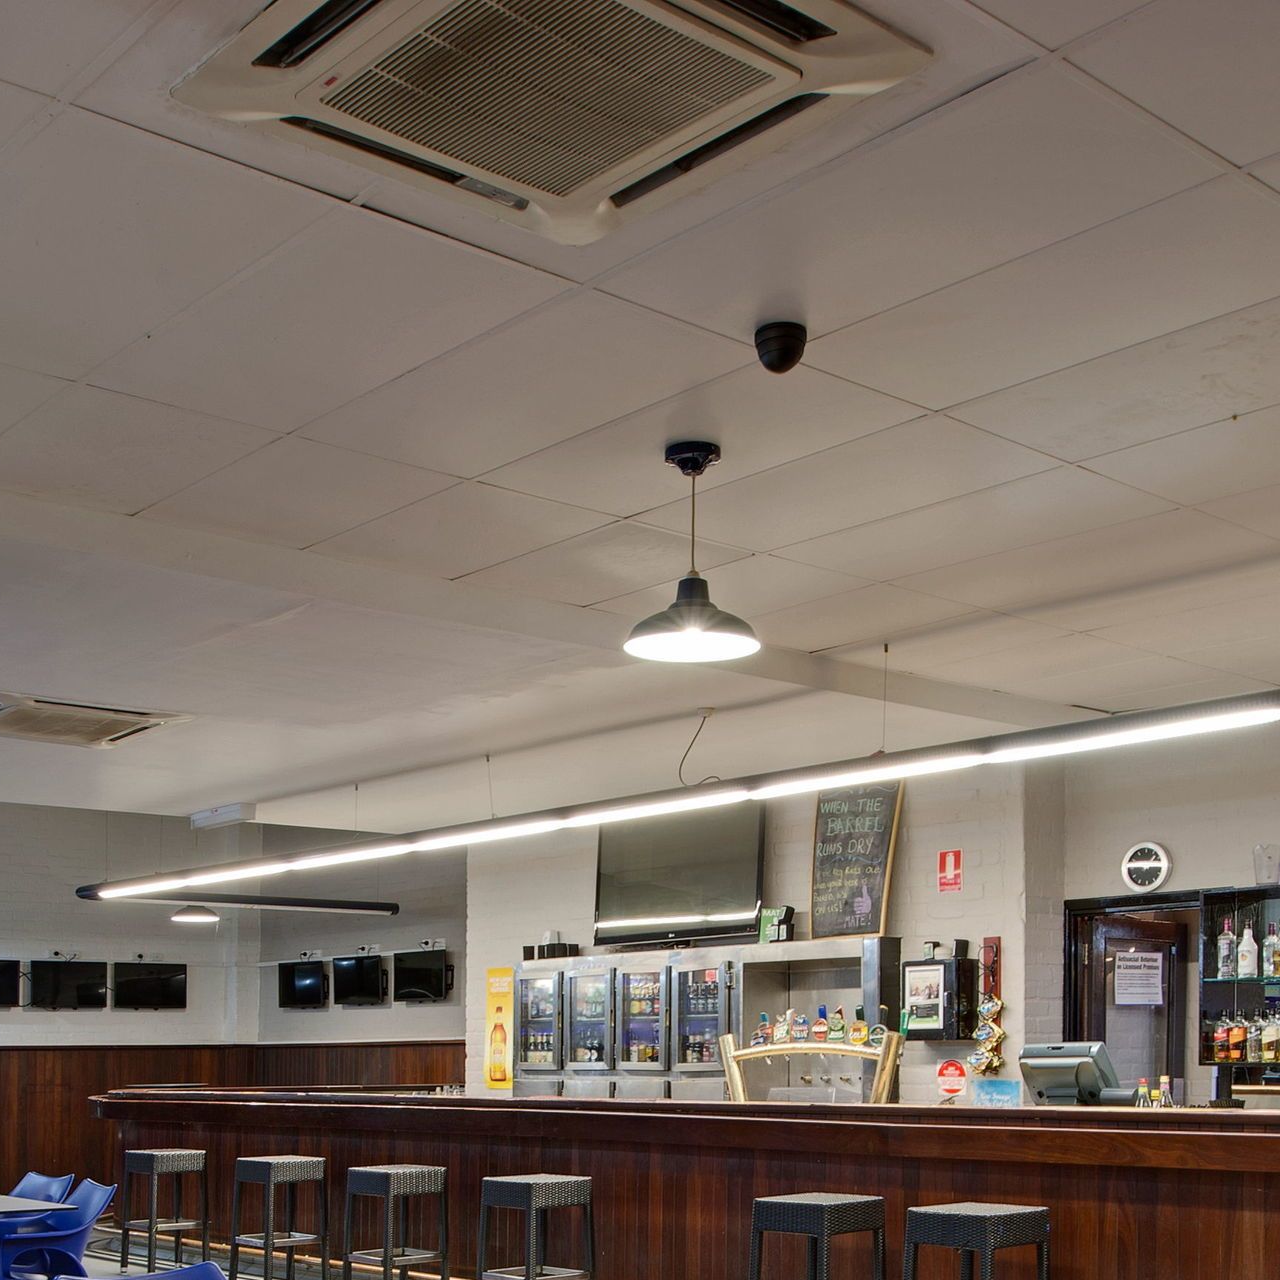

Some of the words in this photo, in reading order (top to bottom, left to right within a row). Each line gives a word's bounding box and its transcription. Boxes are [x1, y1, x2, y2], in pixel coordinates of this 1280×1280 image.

[820, 801, 848, 814] WHEN
[857, 797, 883, 812] THE
[825, 816, 885, 836] BARREL
[816, 842, 842, 857] RUNS
[848, 836, 874, 855] DRY
[843, 912, 872, 929] MATE!
